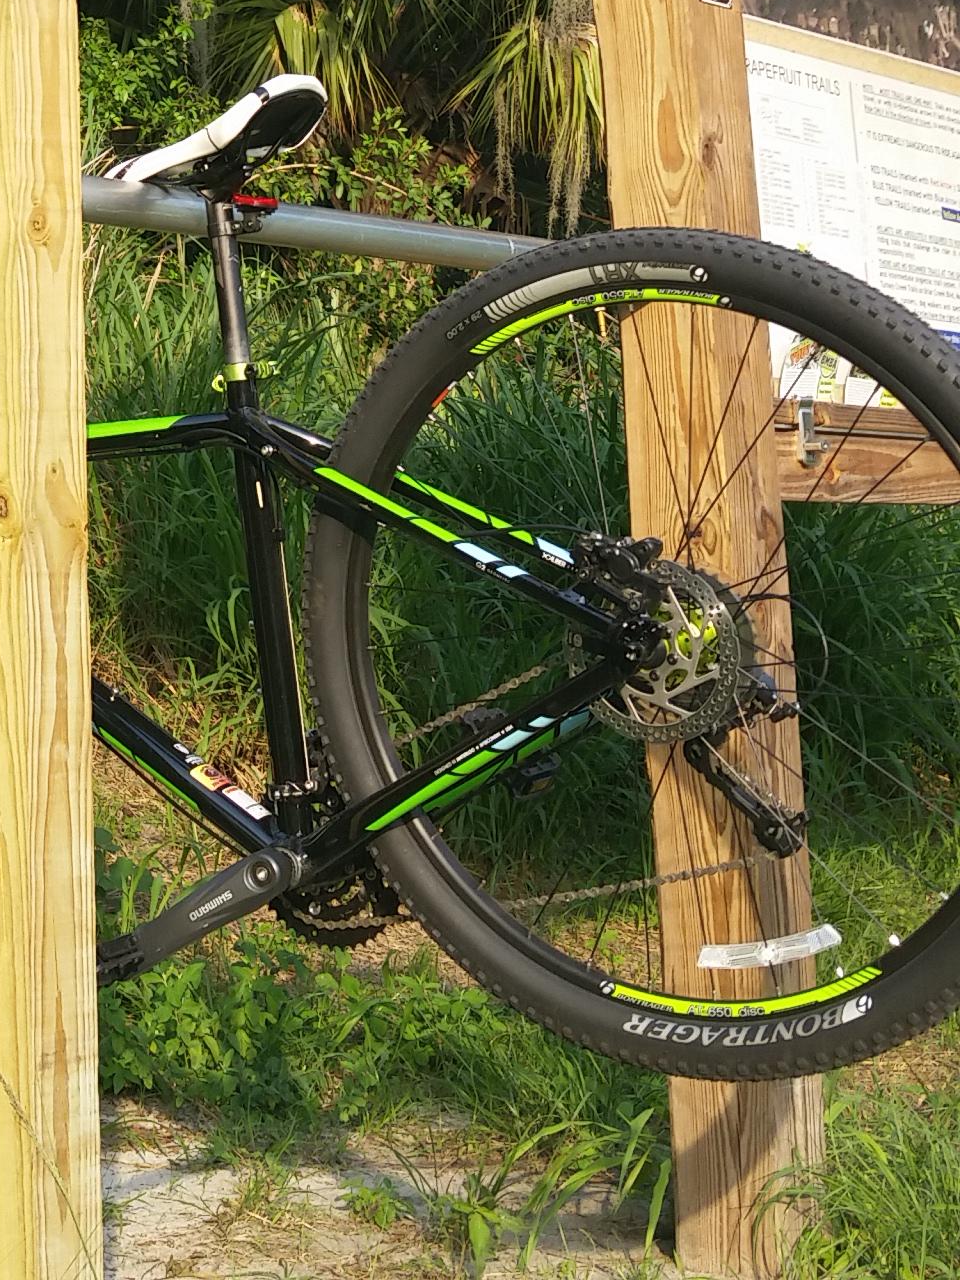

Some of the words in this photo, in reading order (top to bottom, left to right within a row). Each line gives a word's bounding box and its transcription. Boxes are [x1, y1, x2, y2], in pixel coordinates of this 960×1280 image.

[805, 72, 841, 97] TRAILS
[189, 889, 233, 922] SHIMANO
[617, 992, 673, 1013] BONTRAGER
[738, 1005, 765, 1018] disc
[622, 1009, 841, 1046] BONTRAGER
